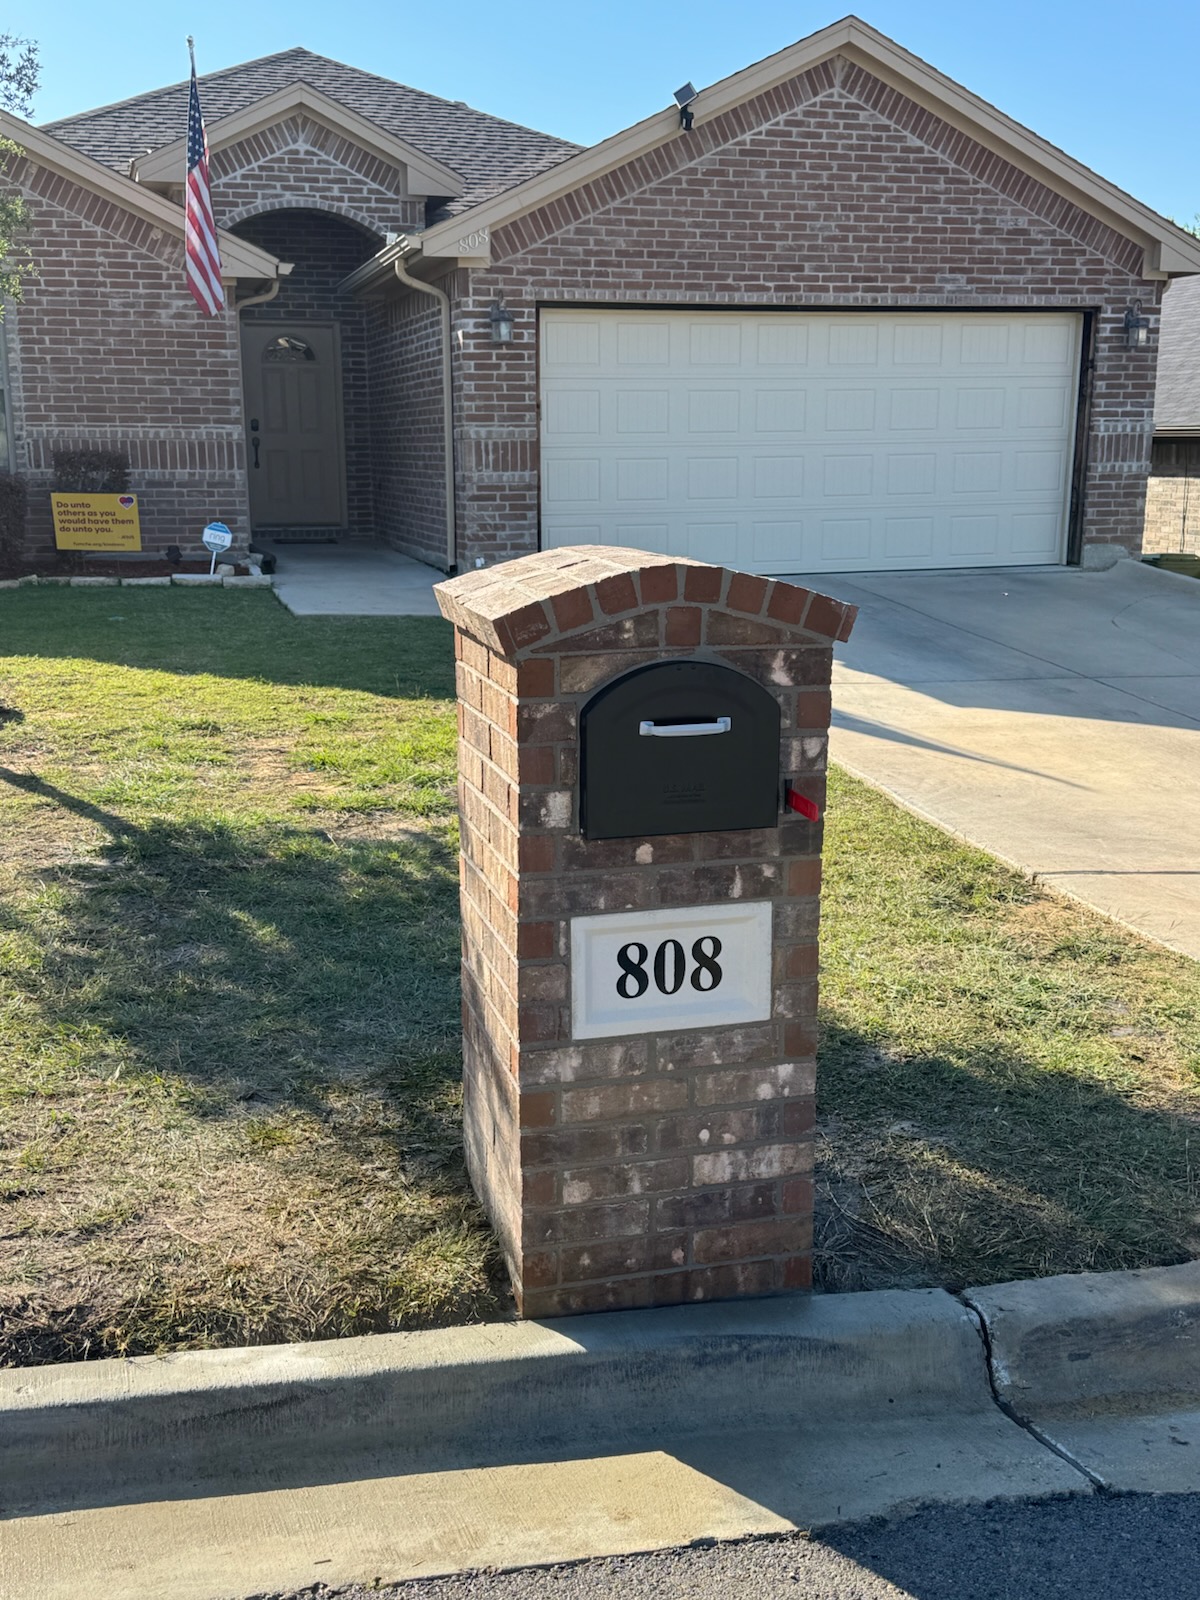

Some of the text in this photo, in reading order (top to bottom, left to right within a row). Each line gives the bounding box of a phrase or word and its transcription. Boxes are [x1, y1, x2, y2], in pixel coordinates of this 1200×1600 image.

[458, 228, 489, 254] 808
[209, 531, 226, 543] ring
[616, 936, 723, 999] 808
